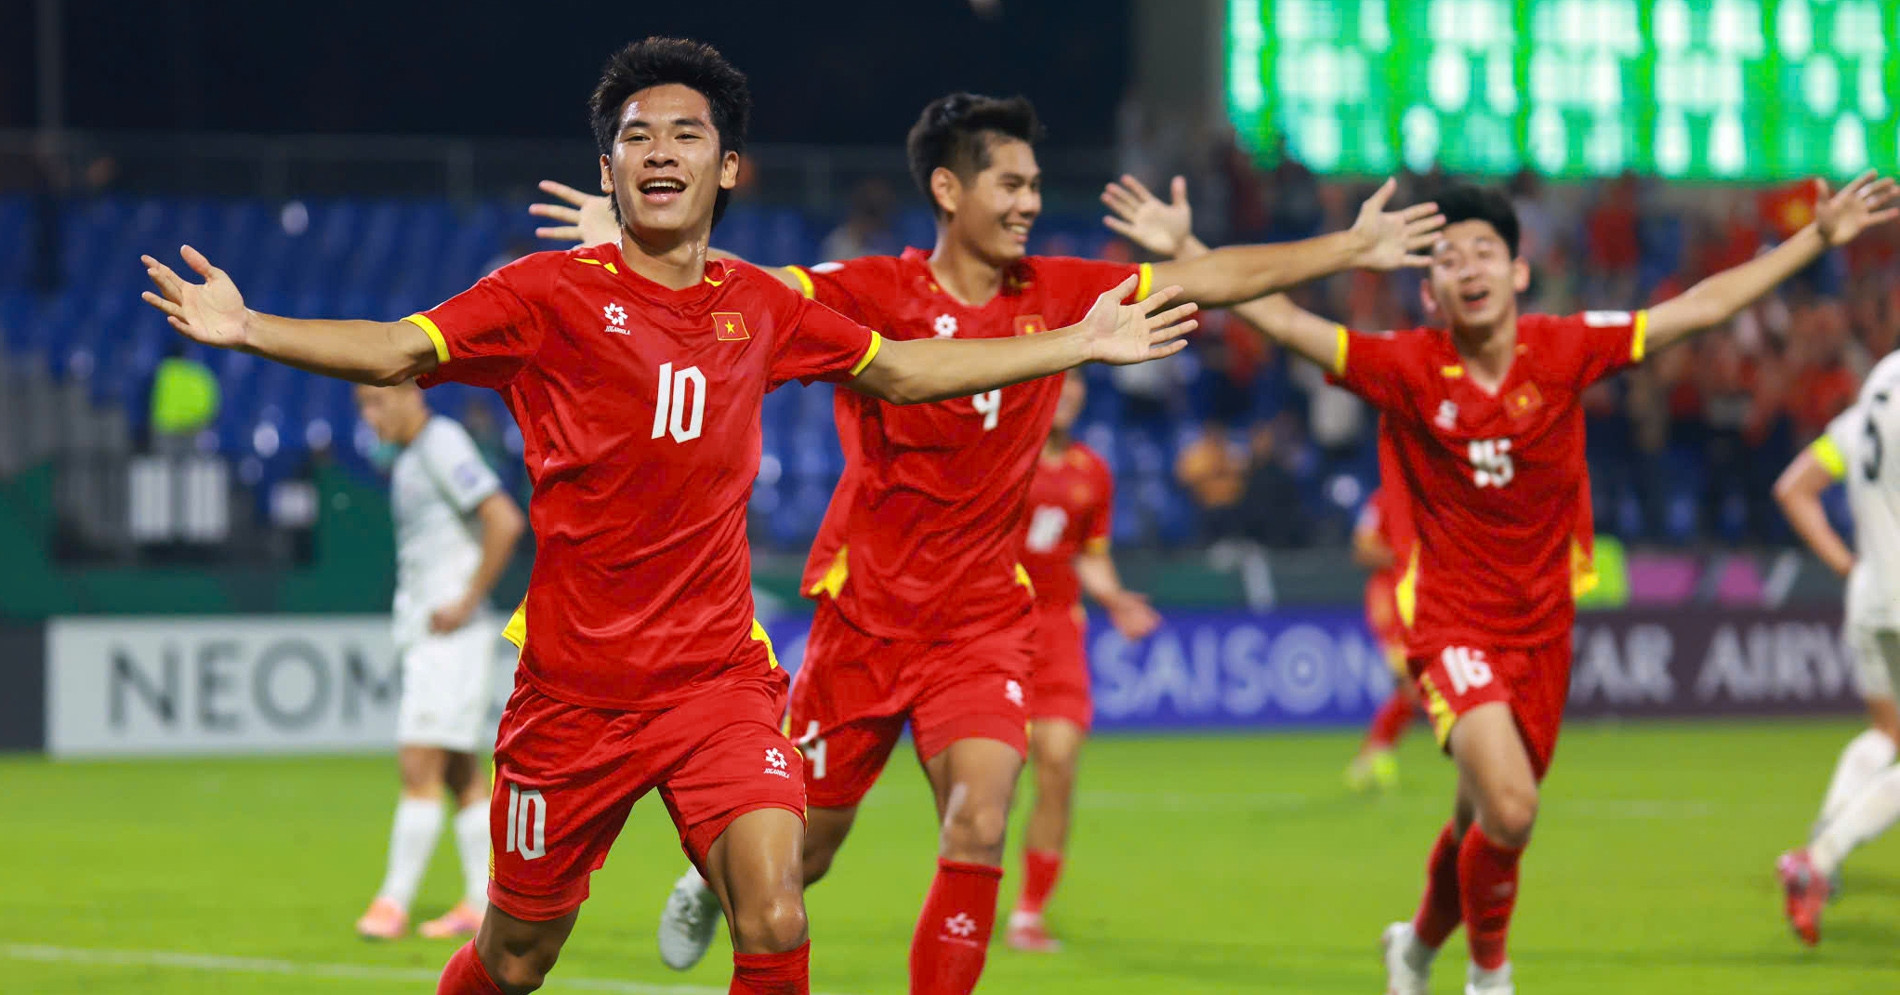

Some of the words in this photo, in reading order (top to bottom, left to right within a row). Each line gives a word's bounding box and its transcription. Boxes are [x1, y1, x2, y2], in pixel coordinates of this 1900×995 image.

[651, 362, 707, 443] 10
[109, 638, 400, 730] NEOM
[1441, 645, 1494, 697] 16
[506, 783, 547, 860] 10
